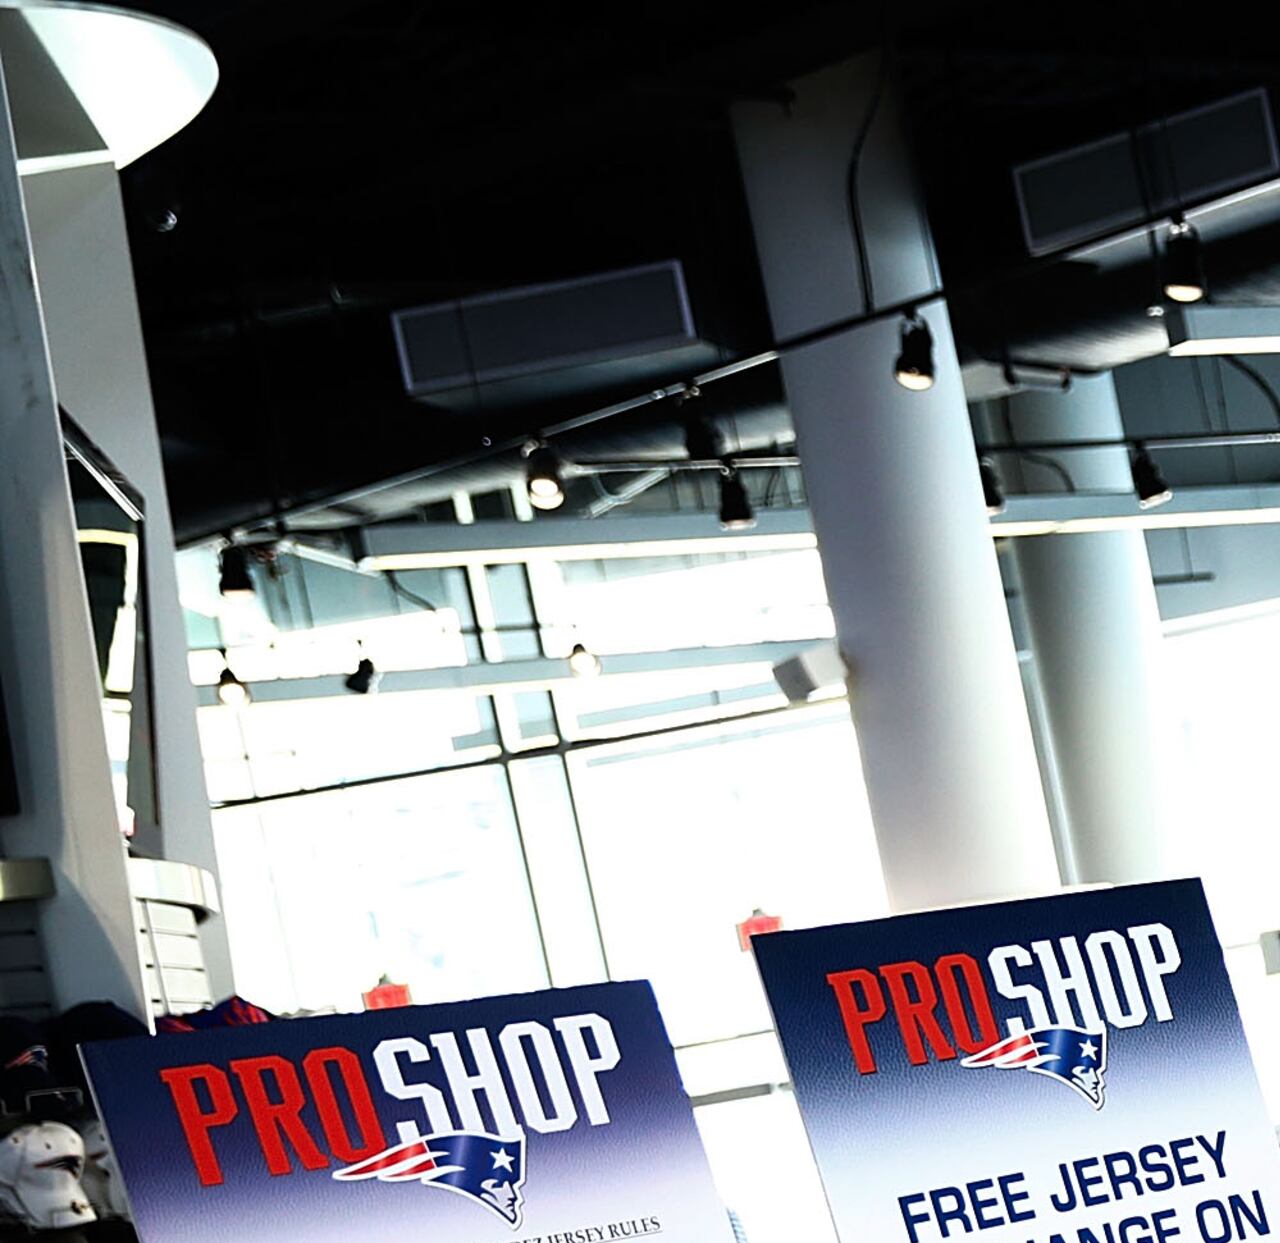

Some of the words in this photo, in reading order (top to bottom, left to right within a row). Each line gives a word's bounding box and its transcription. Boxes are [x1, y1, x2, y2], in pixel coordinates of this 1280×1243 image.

[1050, 1131, 1228, 1212] JERSEY
[606, 1214, 662, 1240] RULES
[1196, 1189, 1271, 1243] ON
